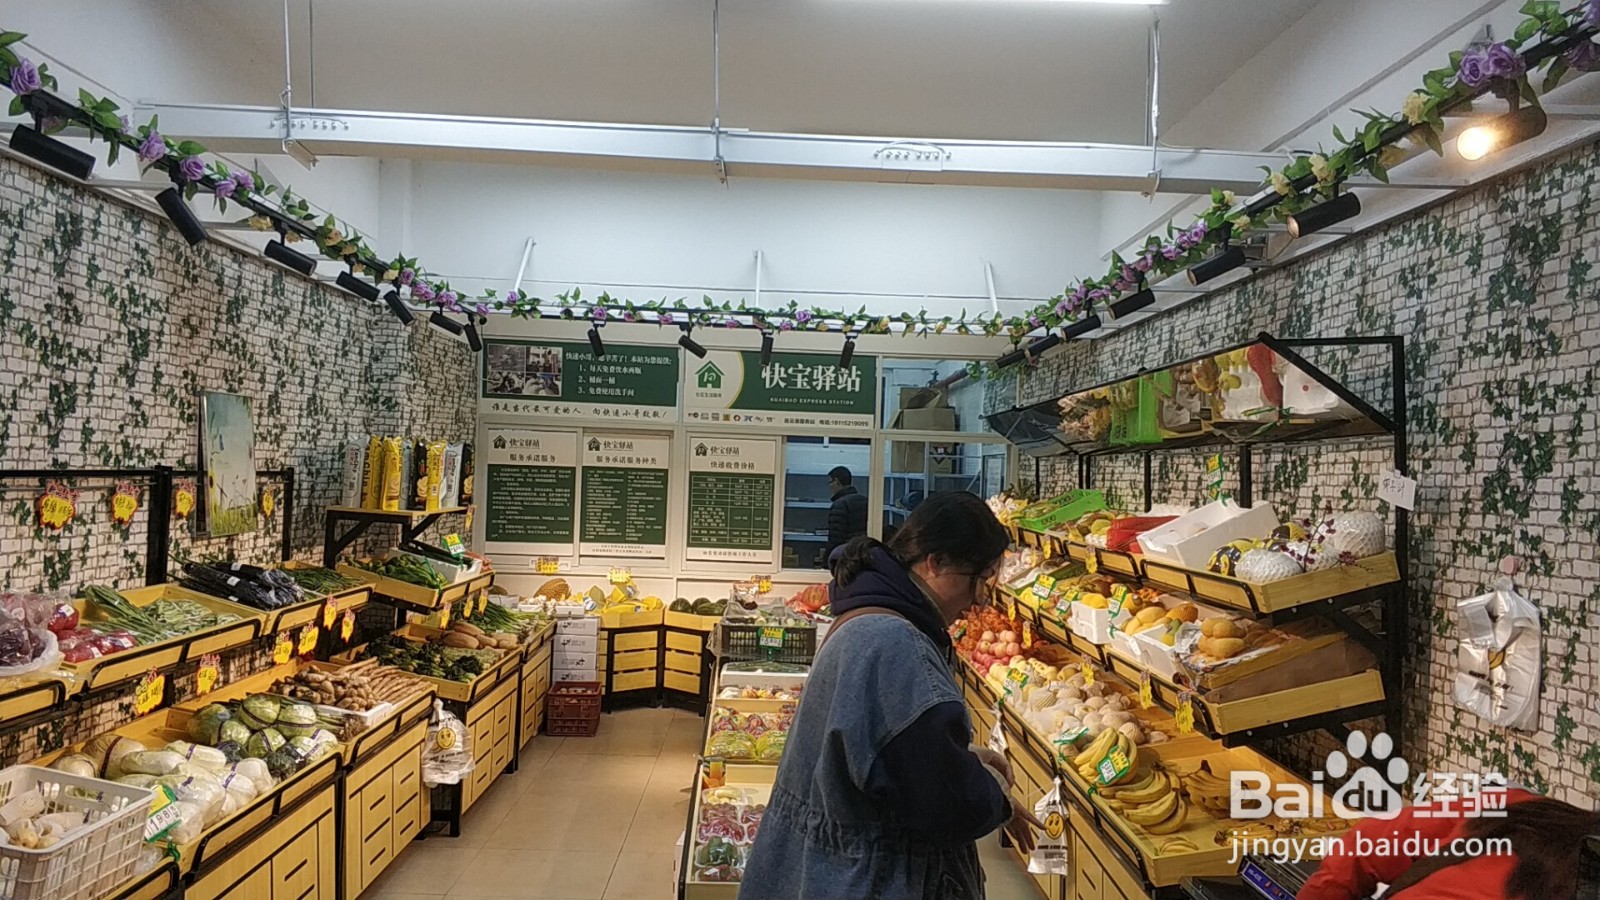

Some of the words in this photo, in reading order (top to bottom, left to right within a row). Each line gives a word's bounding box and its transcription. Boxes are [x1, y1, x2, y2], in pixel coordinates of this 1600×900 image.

[761, 362, 862, 393] 快宝驿站
[509, 437, 540, 448] 快宝驿站
[603, 439, 634, 450] 快宝驿站
[710, 445, 740, 456] 快宝驿站
[710, 460, 755, 470] 快递收费价格
